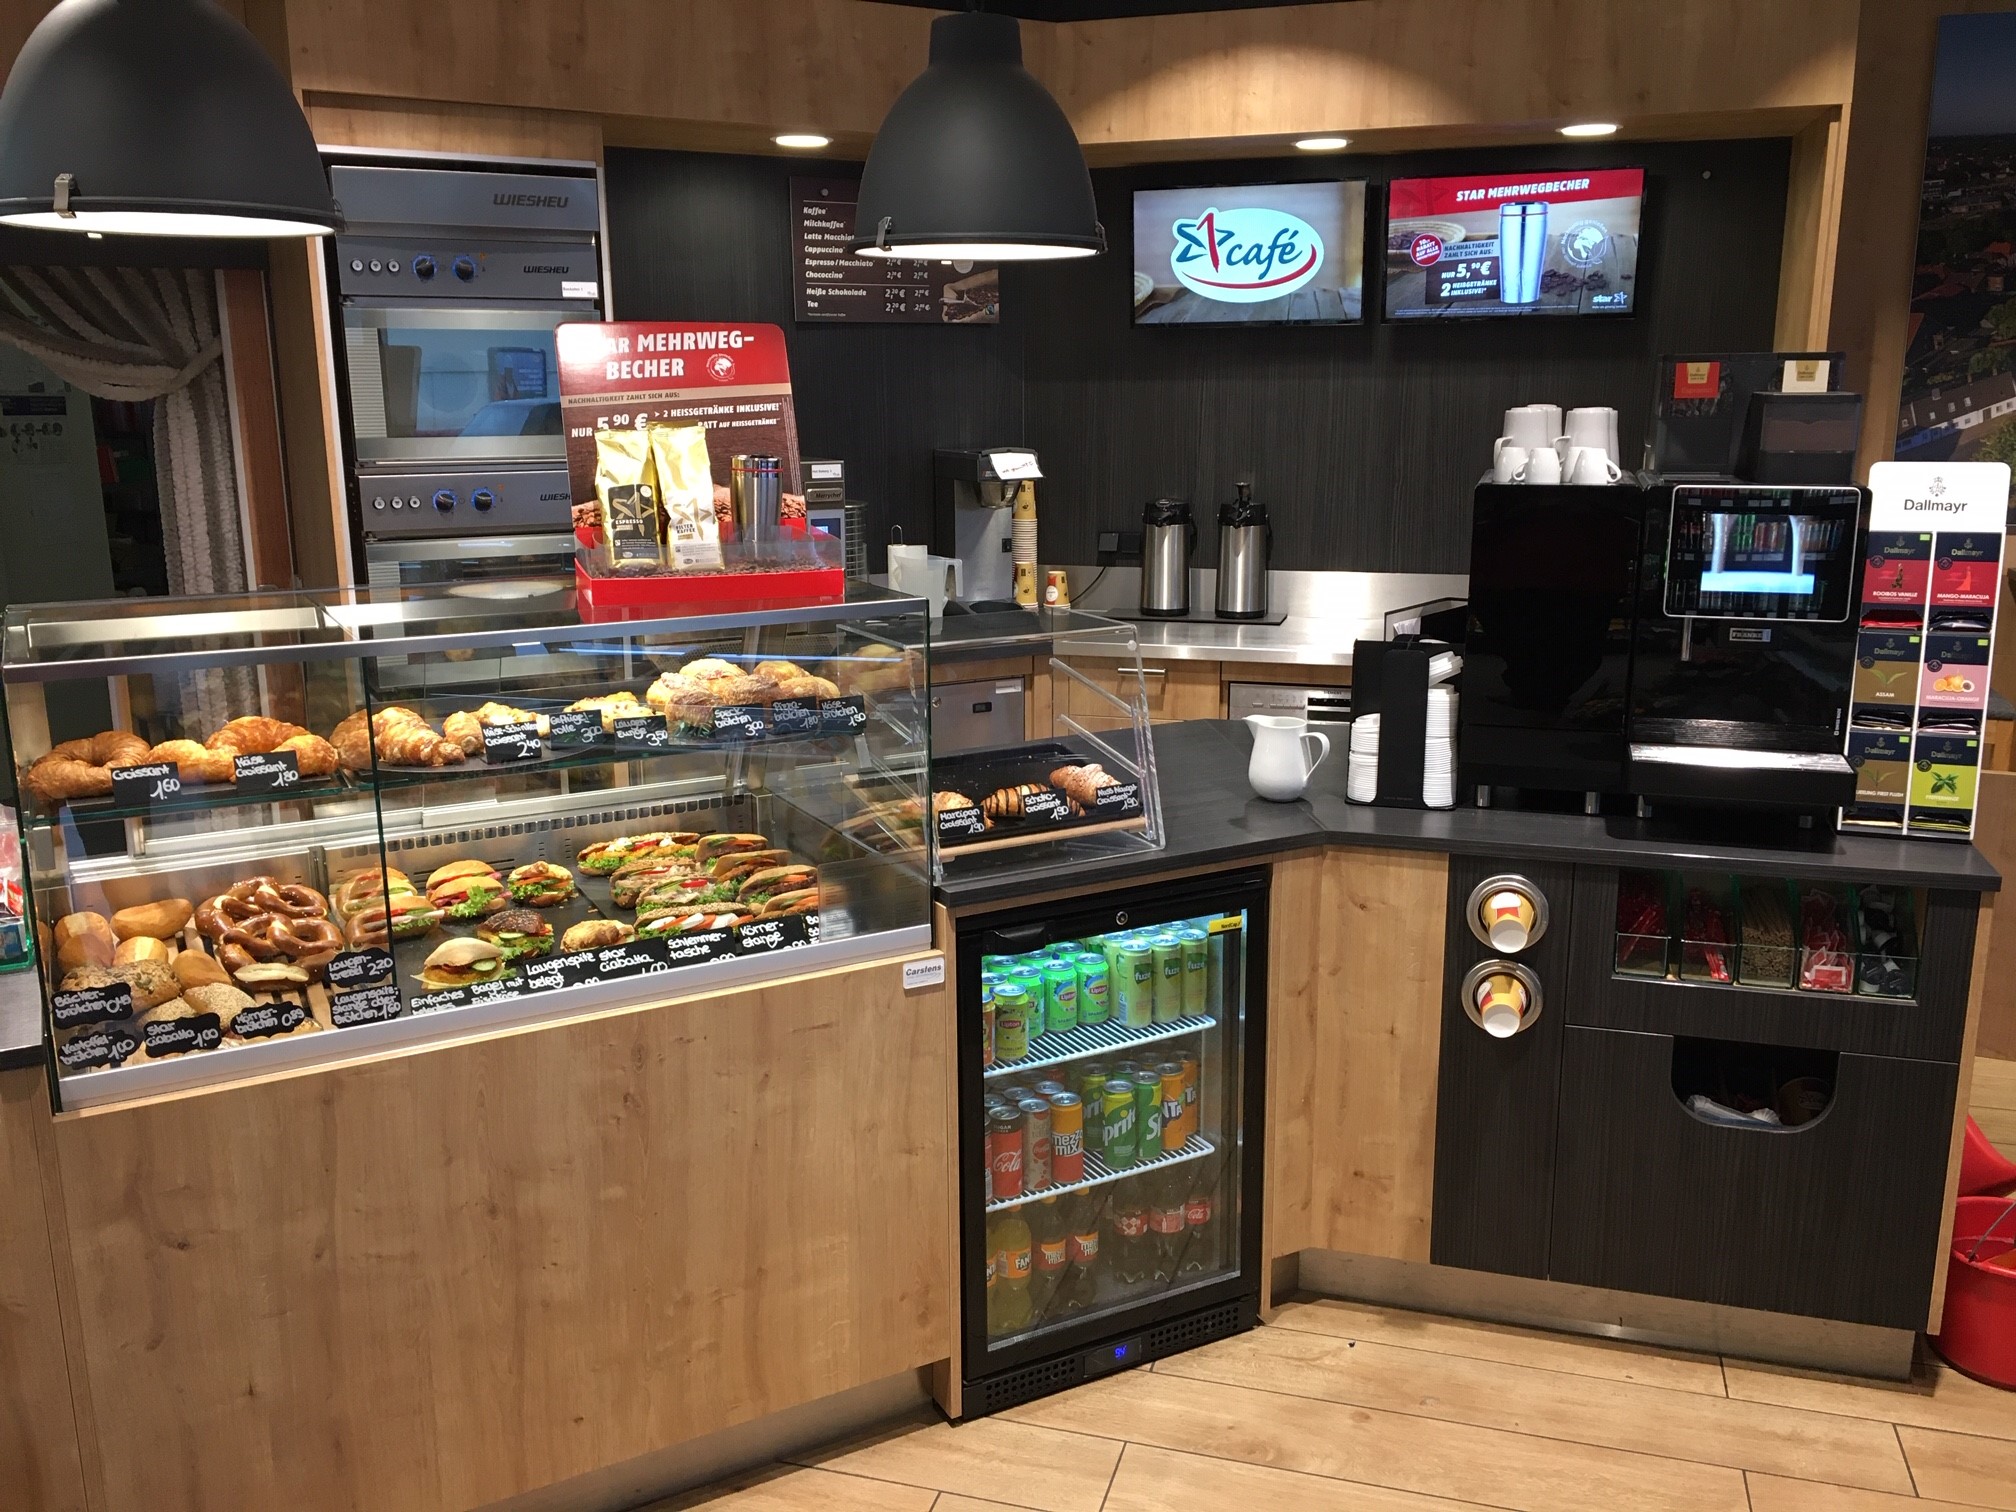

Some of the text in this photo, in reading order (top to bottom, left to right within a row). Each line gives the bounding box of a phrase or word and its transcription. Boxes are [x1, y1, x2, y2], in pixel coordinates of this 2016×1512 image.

[1456, 178, 1590, 201] STAR MEHRWEGBECHER
[493, 194, 569, 208] WIESHEU
[1444, 241, 1495, 251] NACHHALTIGKEIT
[1464, 249, 1479, 257] SICH
[1227, 228, 1302, 280] café
[523, 265, 570, 275] WIESHEU
[1441, 271, 1455, 279] NUR
[806, 288, 826, 296] Heiße
[1440, 282, 1451, 297] 2
[1592, 294, 1613, 303] star
[637, 330, 755, 354] MEHRWEG-
[606, 358, 685, 381] BECHER
[568, 391, 681, 405] NACHHALTIGKEIT ZAHLT SICH AUS:
[663, 410, 669, 419] 2
[670, 404, 735, 418] HEISSGETRÄNKE
[572, 427, 594, 438] NUR
[1904, 499, 1968, 515] Dallmayr
[1884, 546, 1916, 556] Dallmayr
[1951, 548, 1984, 558] Dallmayr
[1874, 647, 1905, 657] Dallmayr
[550, 712, 594, 726] Geflügel-
[714, 707, 746, 718] Speck-
[773, 707, 810, 722] brötchen
[821, 705, 858, 719] brötchen
[714, 714, 752, 729] brötchen
[551, 724, 577, 735] rolle
[1864, 746, 1896, 756] Dallmayr
[1931, 751, 1962, 760] Dallmayr
[235, 755, 265, 768] Käse
[111, 765, 170, 781] Croissant
[150, 778, 180, 800] 1.60
[1024, 793, 1057, 806] Schoko-
[739, 921, 784, 937] Körner-
[668, 932, 727, 950] Schlemmer-
[670, 943, 711, 960] tasche
[905, 964, 942, 977] Carstens
[1164, 966, 1180, 977] fuze
[1187, 960, 1205, 970] fuze
[528, 974, 565, 989] belegt
[1135, 970, 1152, 982] fuze
[470, 976, 525, 996] Bagel mit
[1091, 986, 1108, 994] Lipton
[371, 995, 397, 1008] oder
[410, 990, 465, 1008] Einfaches
[55, 1000, 107, 1019] brötchen
[236, 1008, 278, 1023] Körner-
[234, 1018, 278, 1034] brötchen
[1001, 1020, 1020, 1028] Lipton
[59, 1046, 108, 1066] brötchen
[1056, 1139, 1079, 1156] mix
